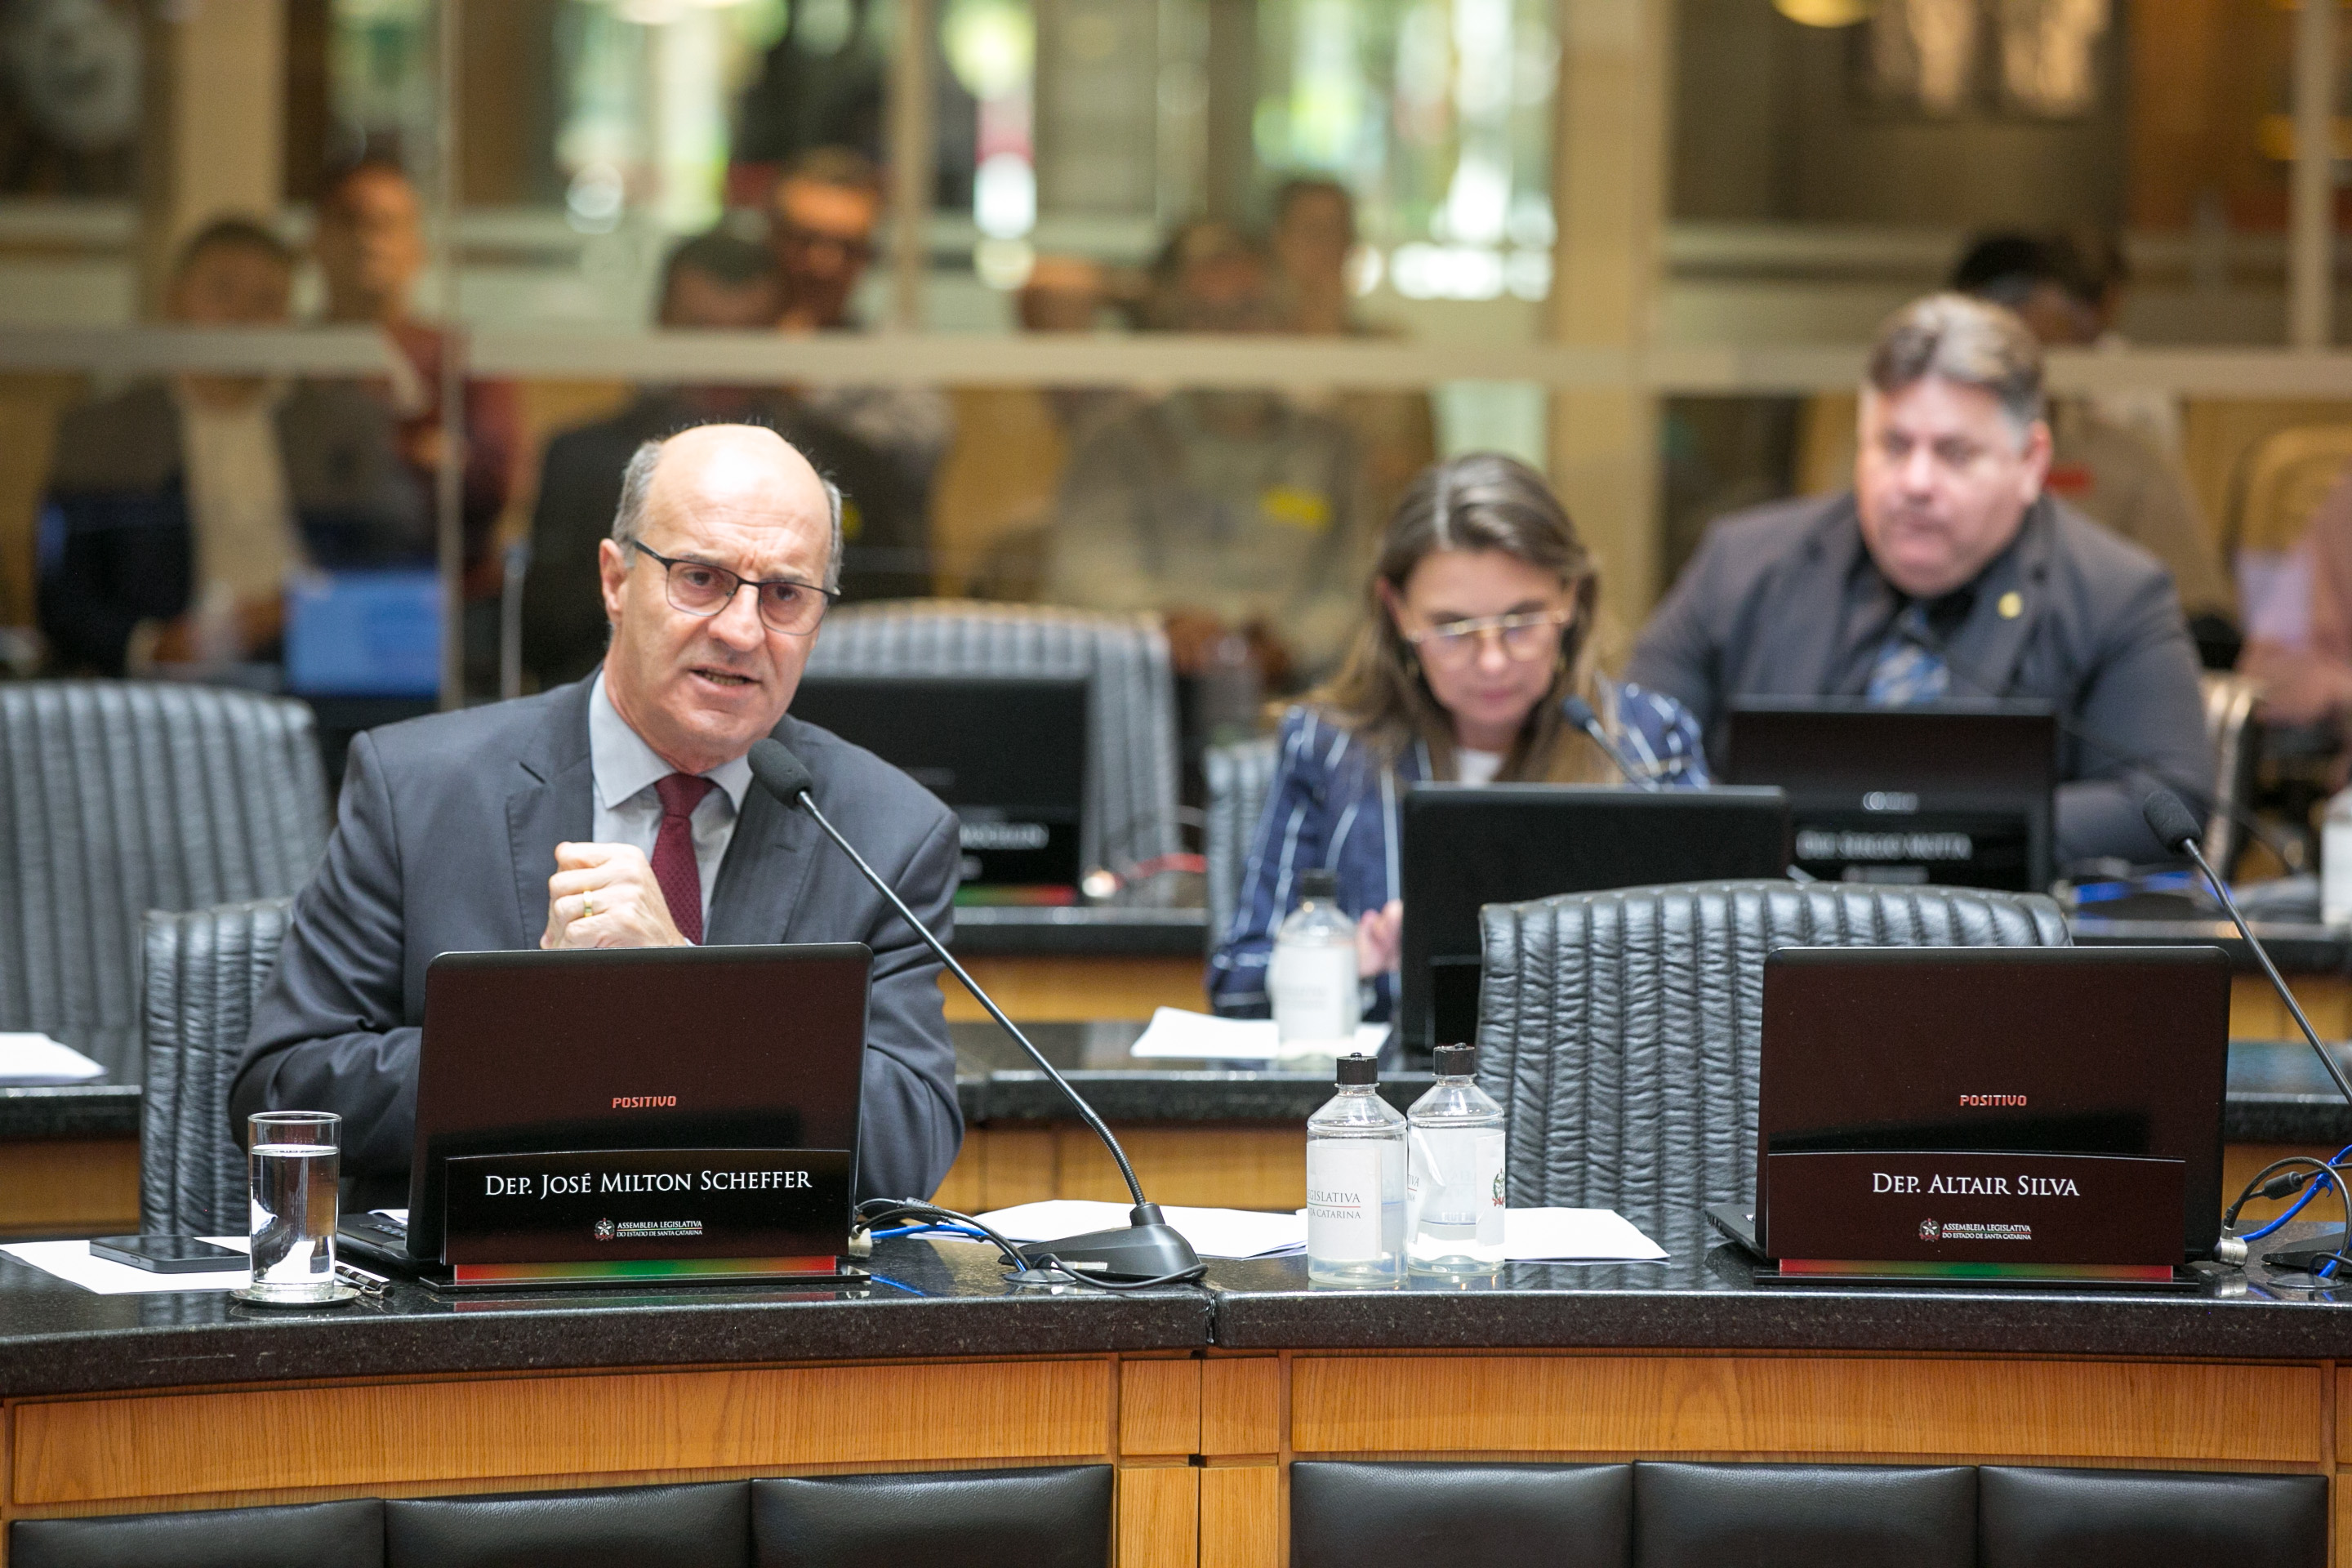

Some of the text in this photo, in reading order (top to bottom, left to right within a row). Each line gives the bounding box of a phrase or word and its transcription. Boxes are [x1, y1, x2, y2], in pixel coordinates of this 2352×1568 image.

[612, 1095, 677, 1109] POSITIVO
[1959, 1094, 2028, 1107] POSITIVO
[485, 1170, 813, 1200] DEP. JOSÉ MILTON SCHEFFER
[1872, 1173, 2081, 1196] DEP. ALTAIR SILVA
[1316, 1209, 1361, 1219] CATARINA
[660, 1220, 702, 1228] LEGISLATIVA
